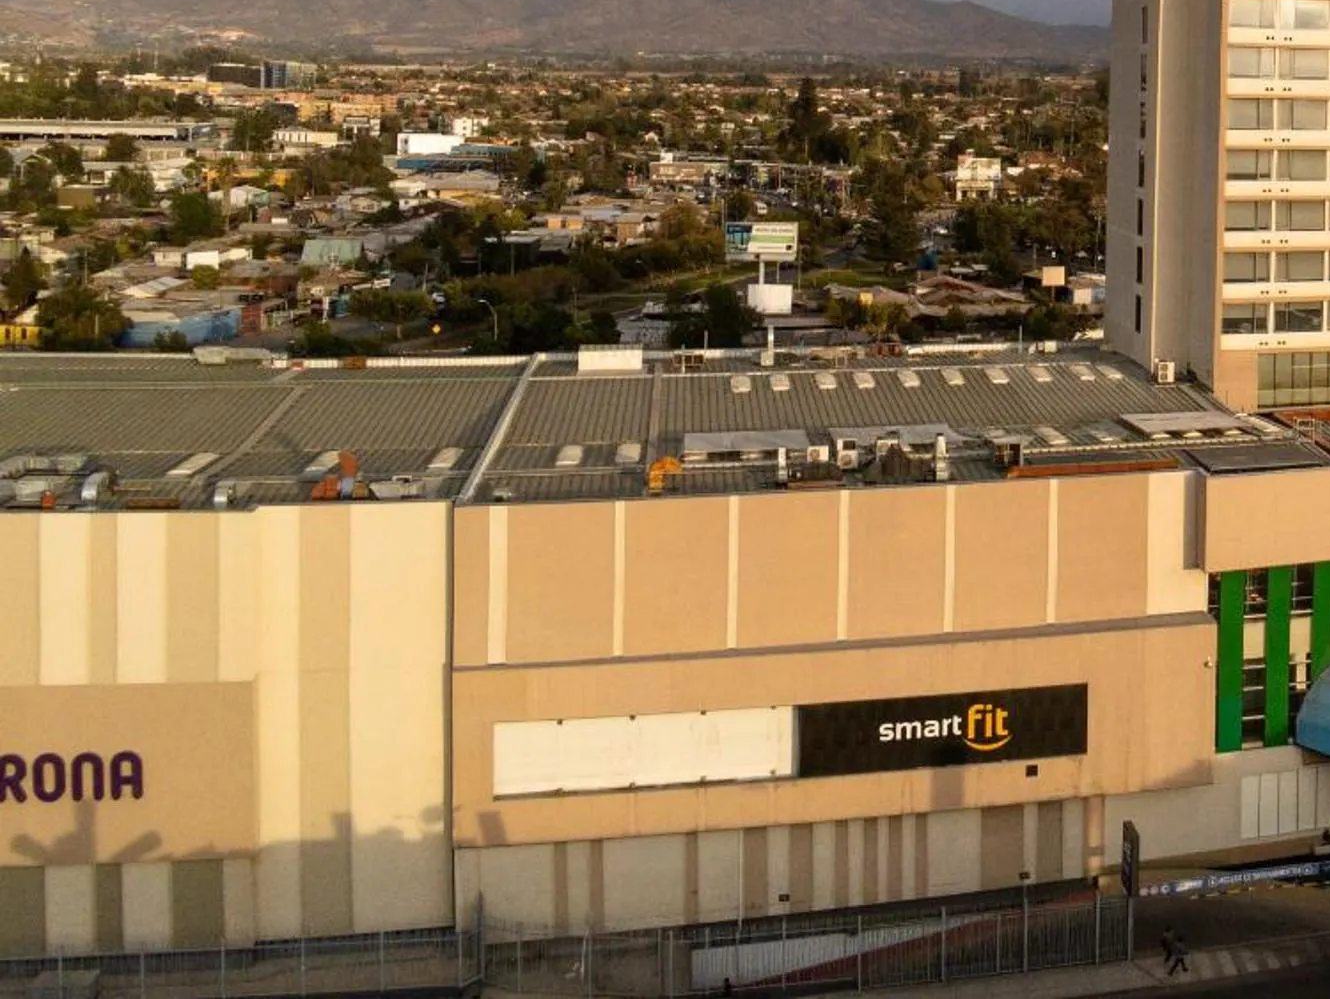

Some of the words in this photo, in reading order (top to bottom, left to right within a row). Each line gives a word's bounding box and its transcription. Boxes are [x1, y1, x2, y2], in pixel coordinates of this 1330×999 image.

[878, 715, 963, 742] smart
[967, 703, 1009, 739] fit
[0, 751, 144, 803] RONA
